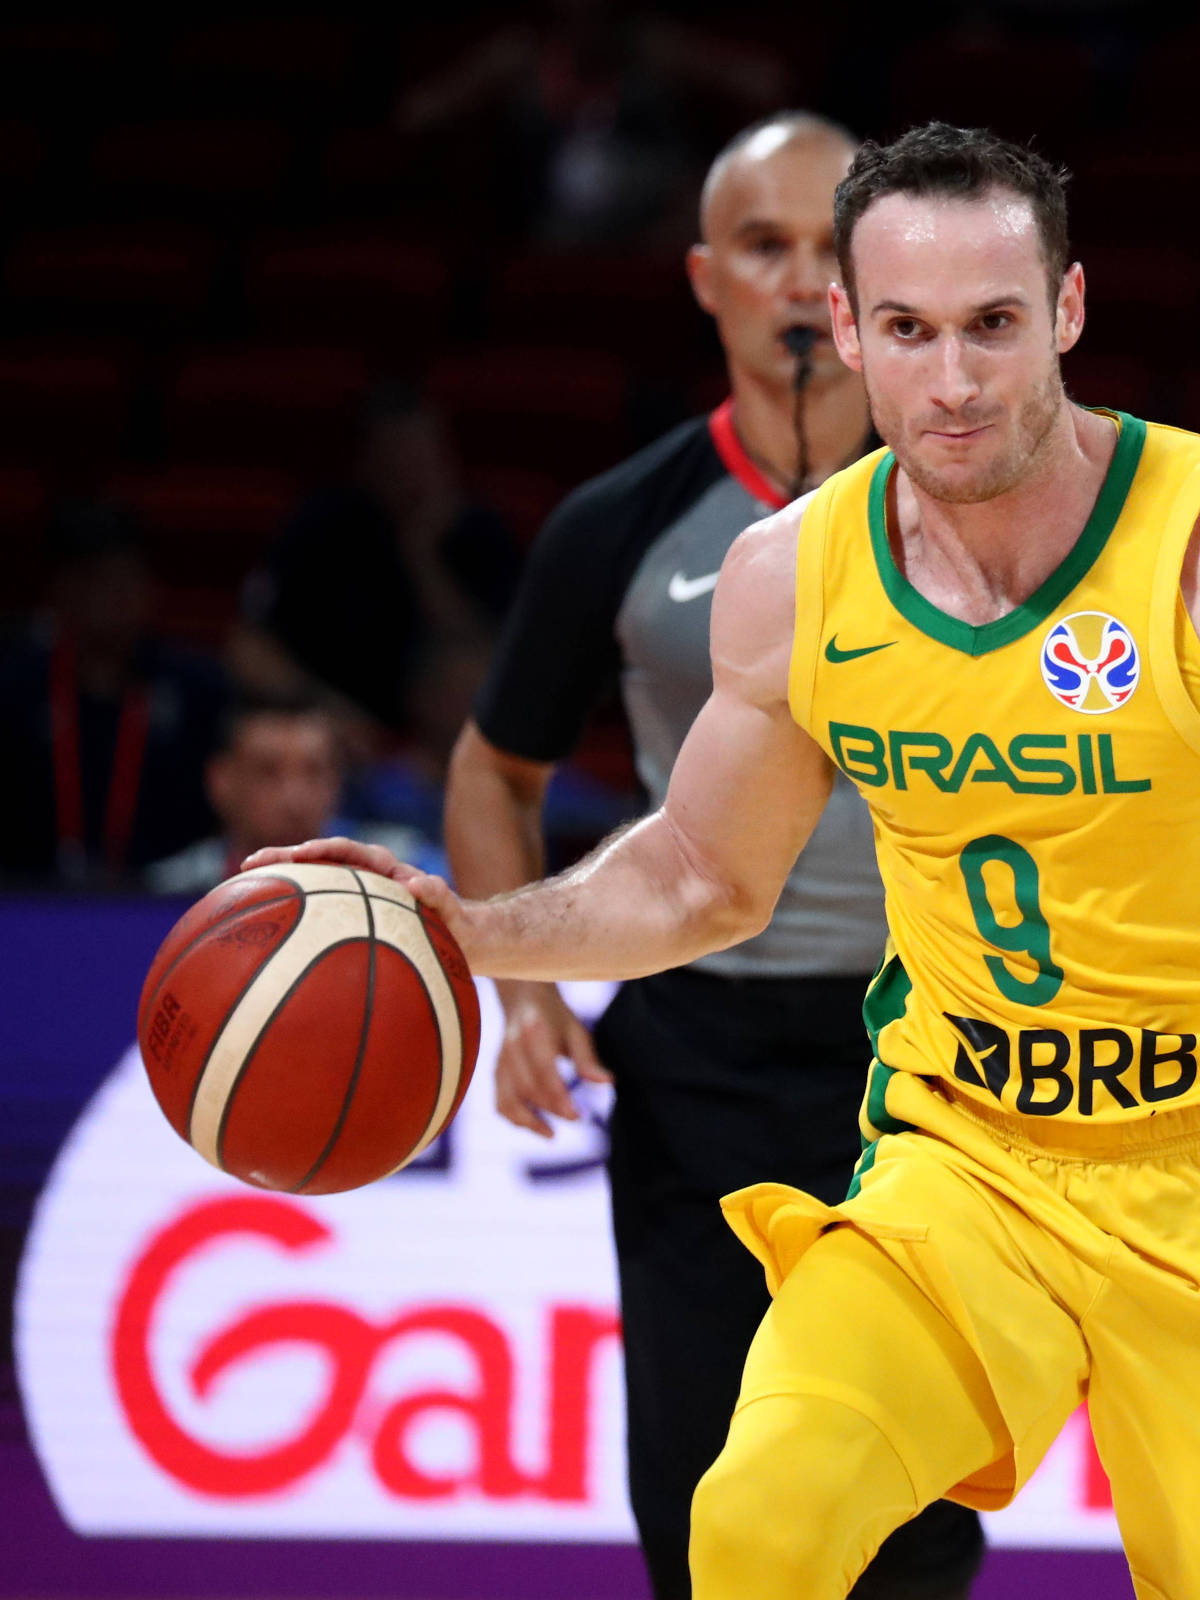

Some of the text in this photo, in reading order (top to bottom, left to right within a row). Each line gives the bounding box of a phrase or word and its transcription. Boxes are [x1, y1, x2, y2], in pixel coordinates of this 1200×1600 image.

[829, 721, 1152, 796] BRASIL
[959, 834, 1064, 1007] 9
[1015, 1028, 1197, 1117] BRB
